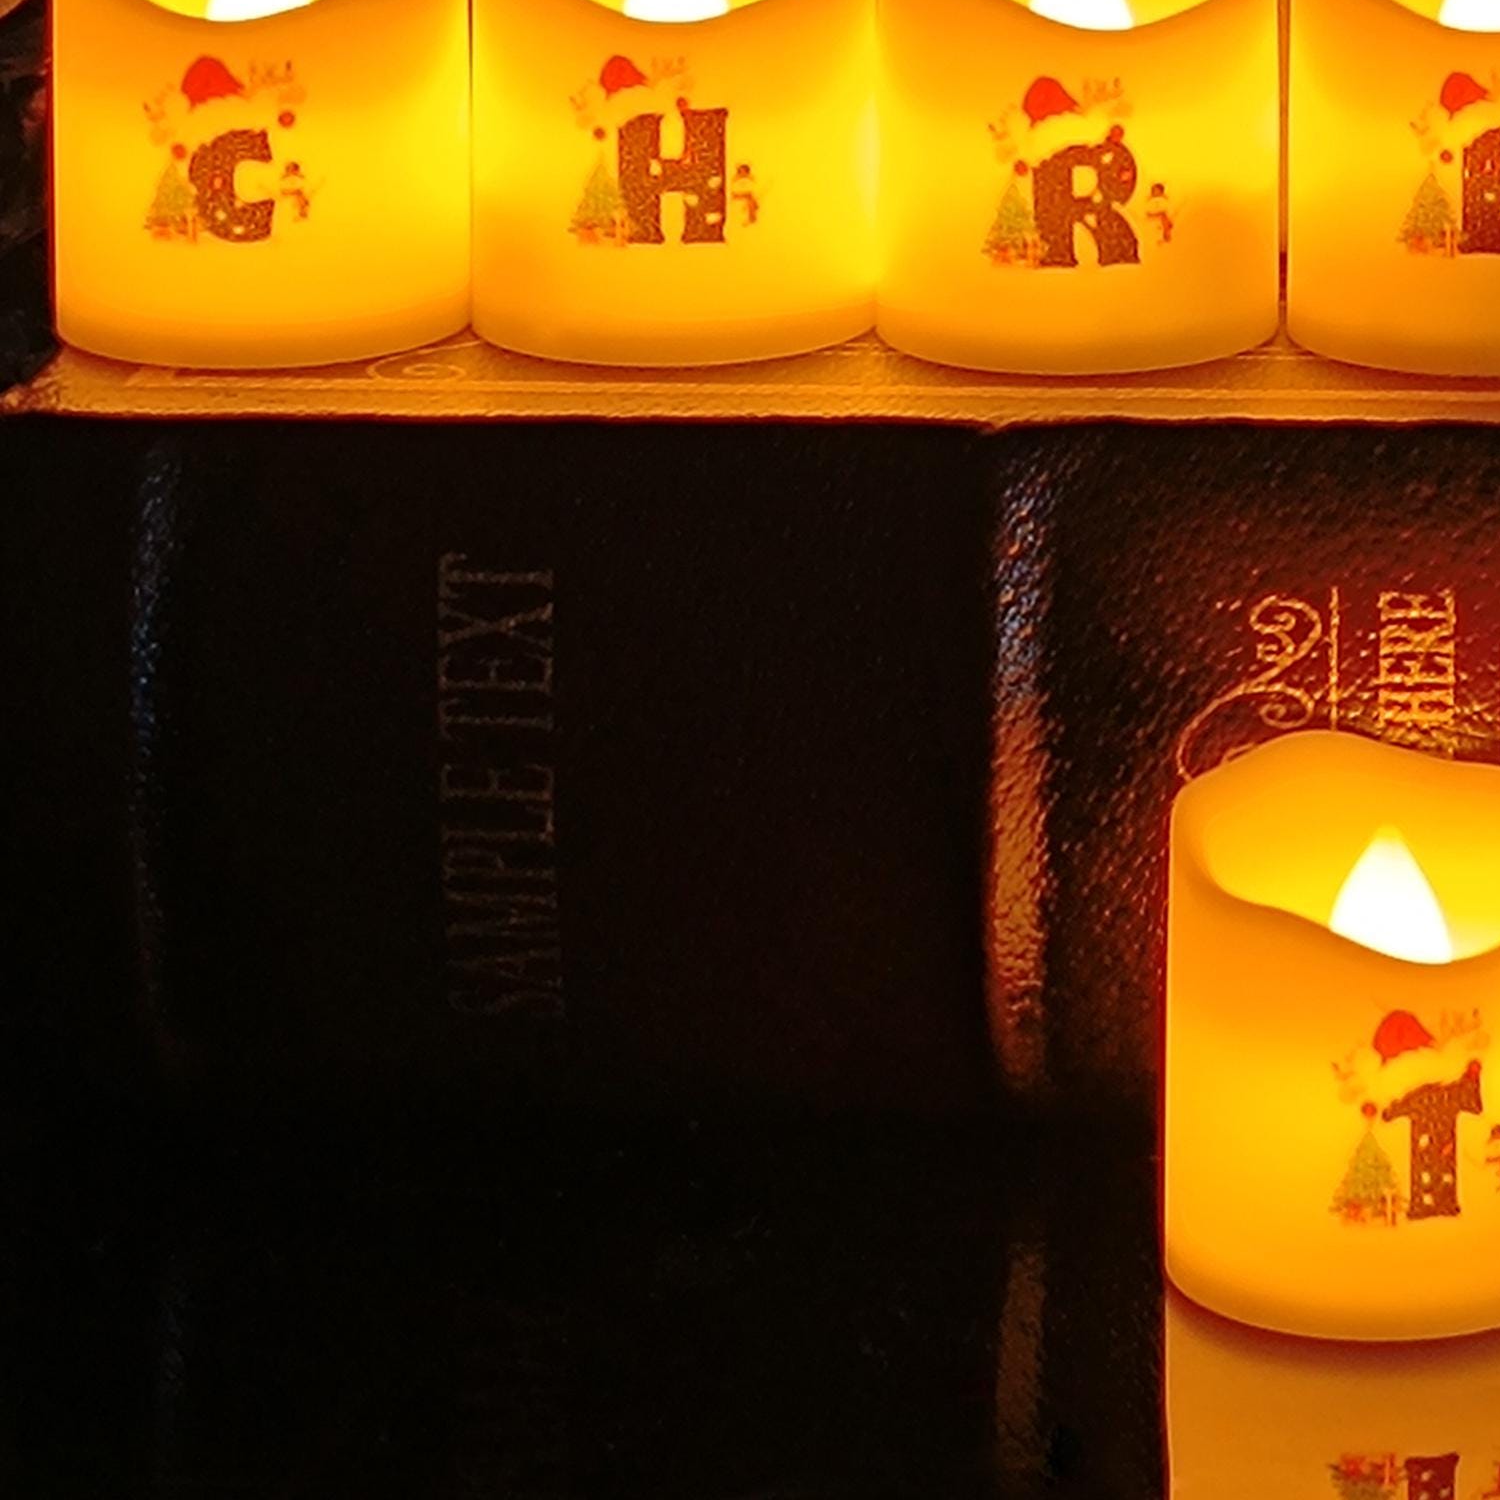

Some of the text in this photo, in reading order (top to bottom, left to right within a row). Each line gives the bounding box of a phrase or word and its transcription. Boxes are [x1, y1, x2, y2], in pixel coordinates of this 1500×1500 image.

[188, 128, 276, 243] C
[616, 106, 729, 245] H
[1031, 140, 1140, 268] R
[438, 552, 565, 1020] SAMPLE TEXT
[1382, 1074, 1483, 1220] T
